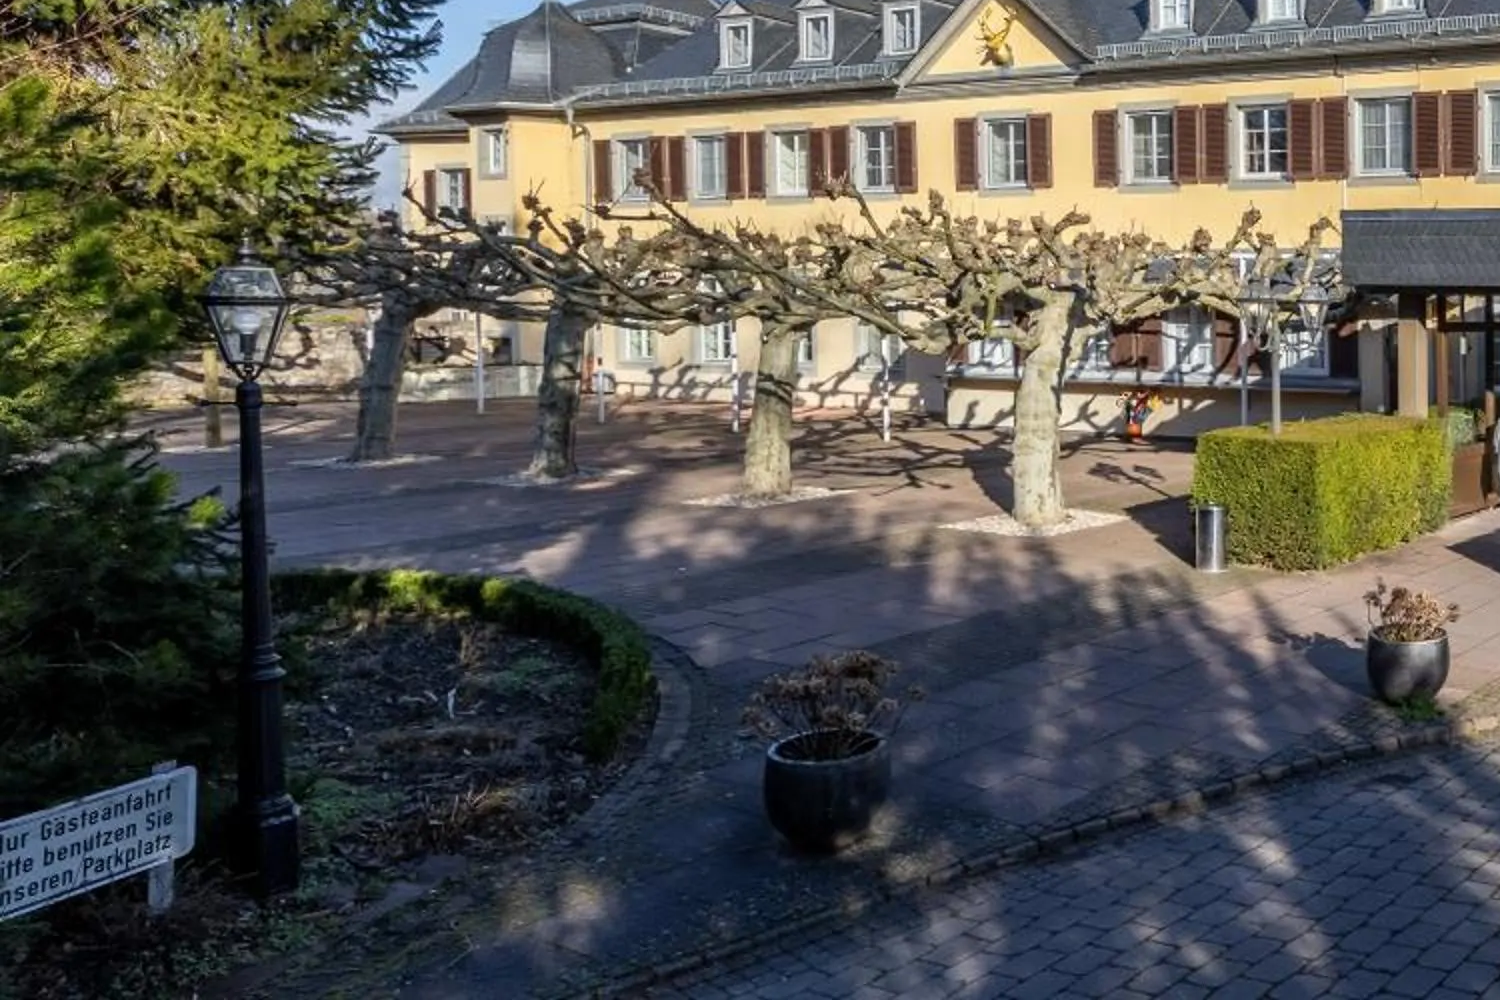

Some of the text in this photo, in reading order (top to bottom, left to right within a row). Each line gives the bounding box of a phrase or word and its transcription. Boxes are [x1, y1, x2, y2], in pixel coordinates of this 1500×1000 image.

[0, 811, 173, 880] itte benutzen Sie
[41, 784, 172, 841] Gästeanfahrt
[0, 834, 171, 905] nseren Parkplatz
